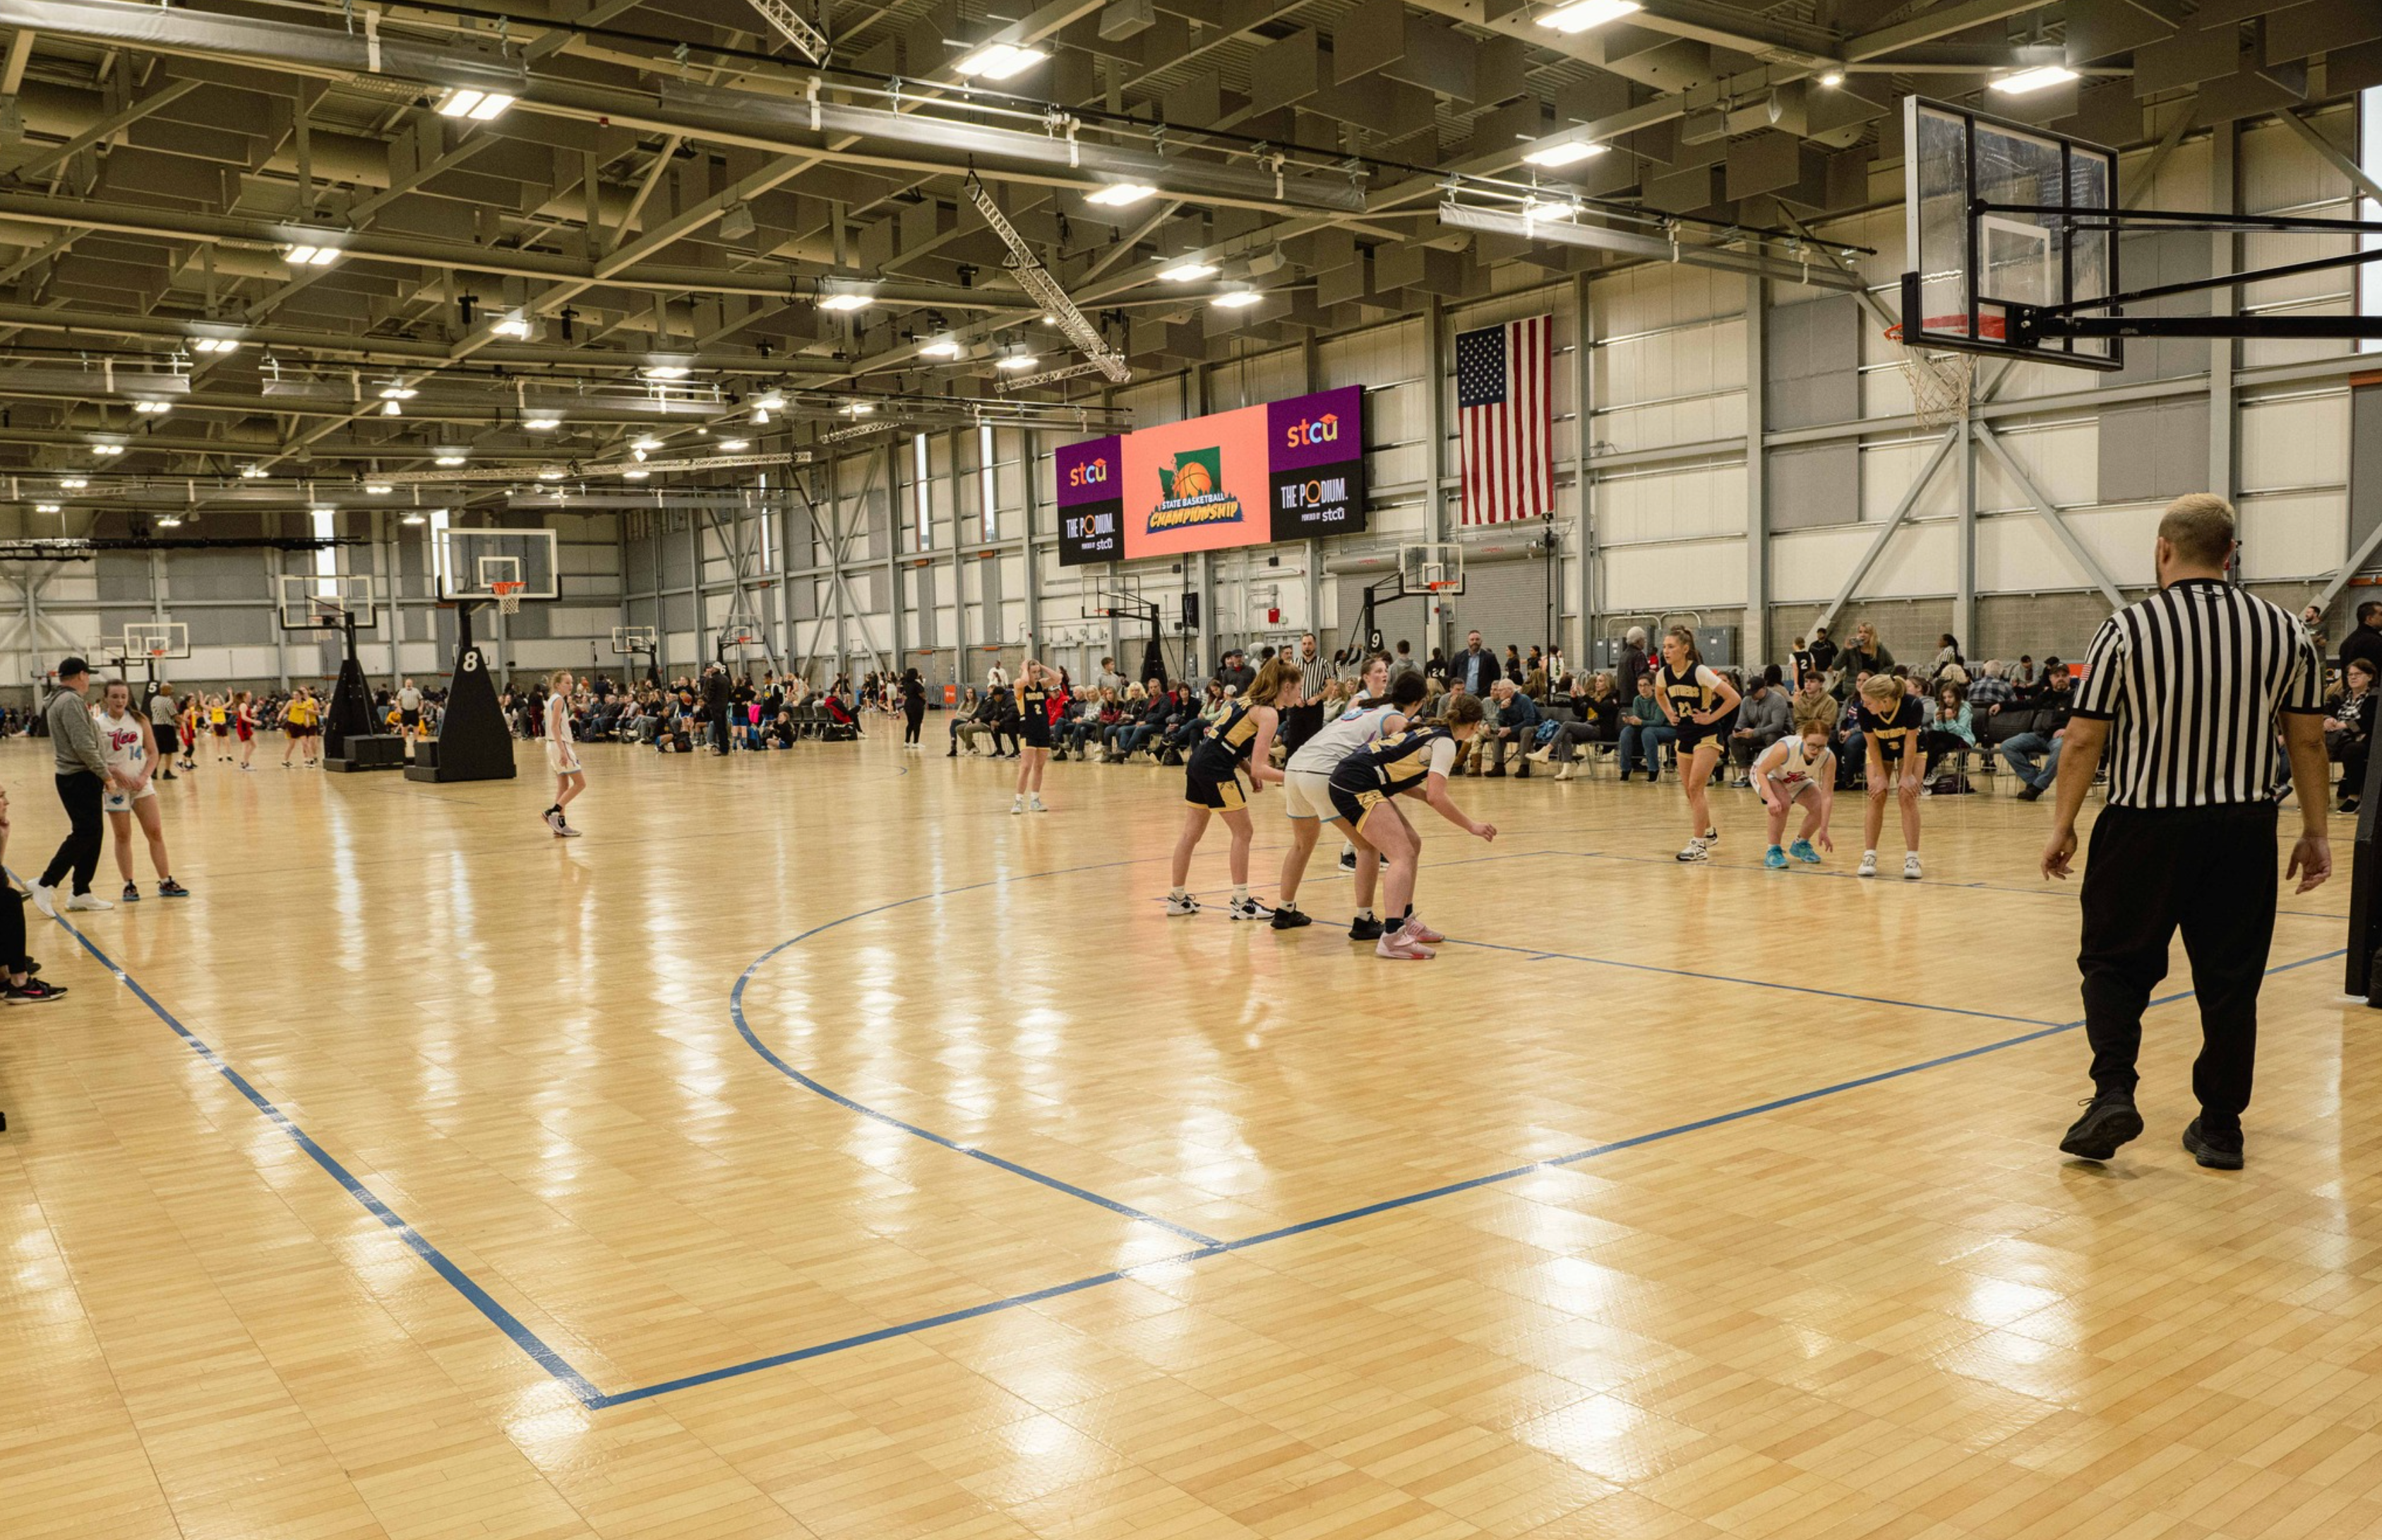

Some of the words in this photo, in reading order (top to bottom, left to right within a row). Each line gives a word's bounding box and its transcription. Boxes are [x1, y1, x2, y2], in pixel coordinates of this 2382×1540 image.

[1287, 414, 1338, 447] stcu
[1070, 459, 1106, 486] stcu
[1162, 499, 1181, 510] STATE
[1183, 493, 1225, 507] BASKETBALL
[1281, 485, 1297, 509] THE
[1150, 502, 1238, 528] CHAMPIONSHIP
[1322, 507, 1345, 522] stcu
[1066, 519, 1078, 539] THE
[1096, 538, 1113, 551] stcu
[1372, 633, 1380, 648] 9
[463, 651, 478, 672] 8
[1800, 659, 1807, 670] 2
[1432, 668, 1445, 678] 24
[148, 682, 157, 693] 5
[1034, 704, 1042, 714] 2
[129, 745, 142, 760] 14
